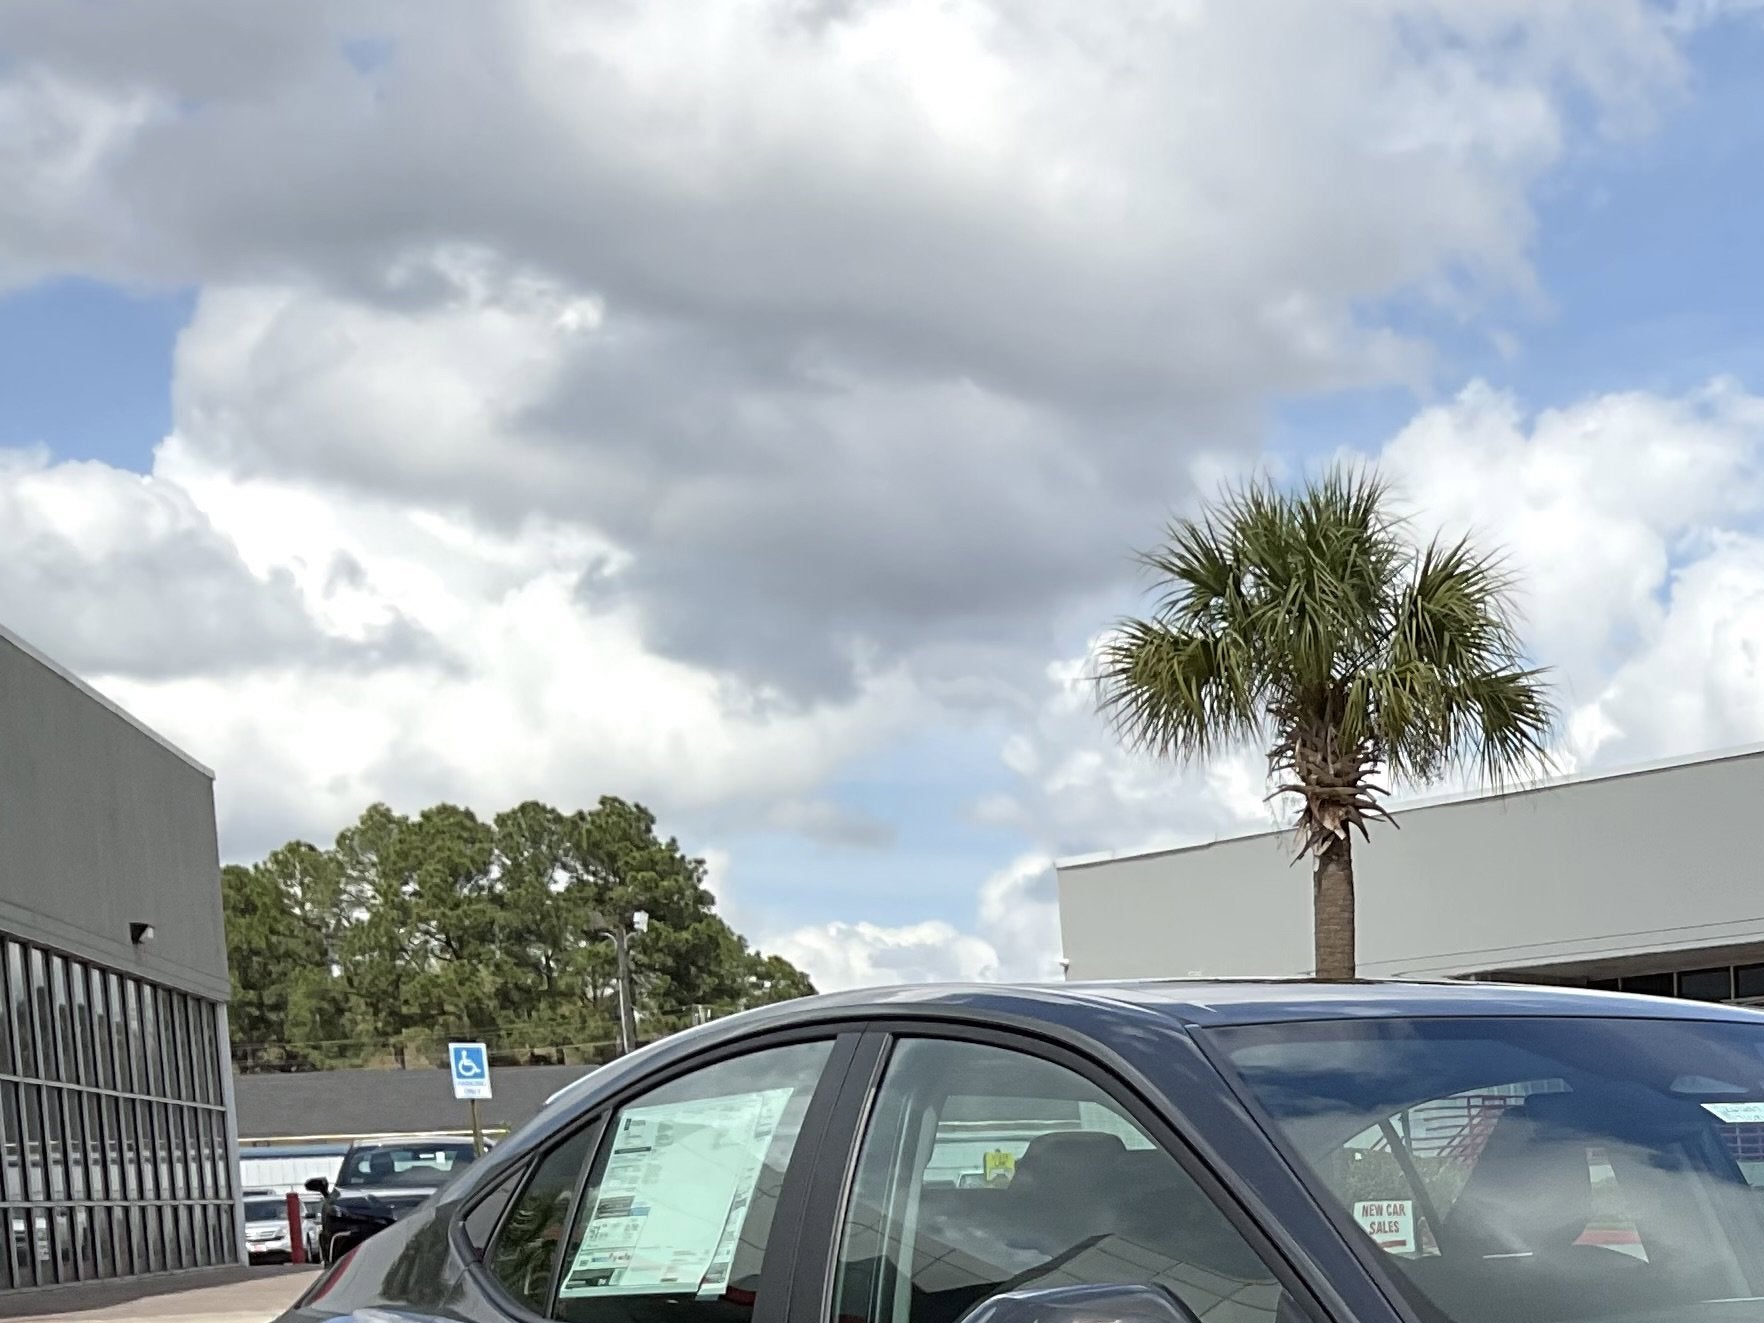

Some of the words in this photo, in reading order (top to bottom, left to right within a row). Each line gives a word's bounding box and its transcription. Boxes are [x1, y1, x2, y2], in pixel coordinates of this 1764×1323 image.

[1361, 1203, 1384, 1217] NEW
[1386, 1203, 1407, 1217] CAR
[1369, 1220, 1401, 1235] SALES
